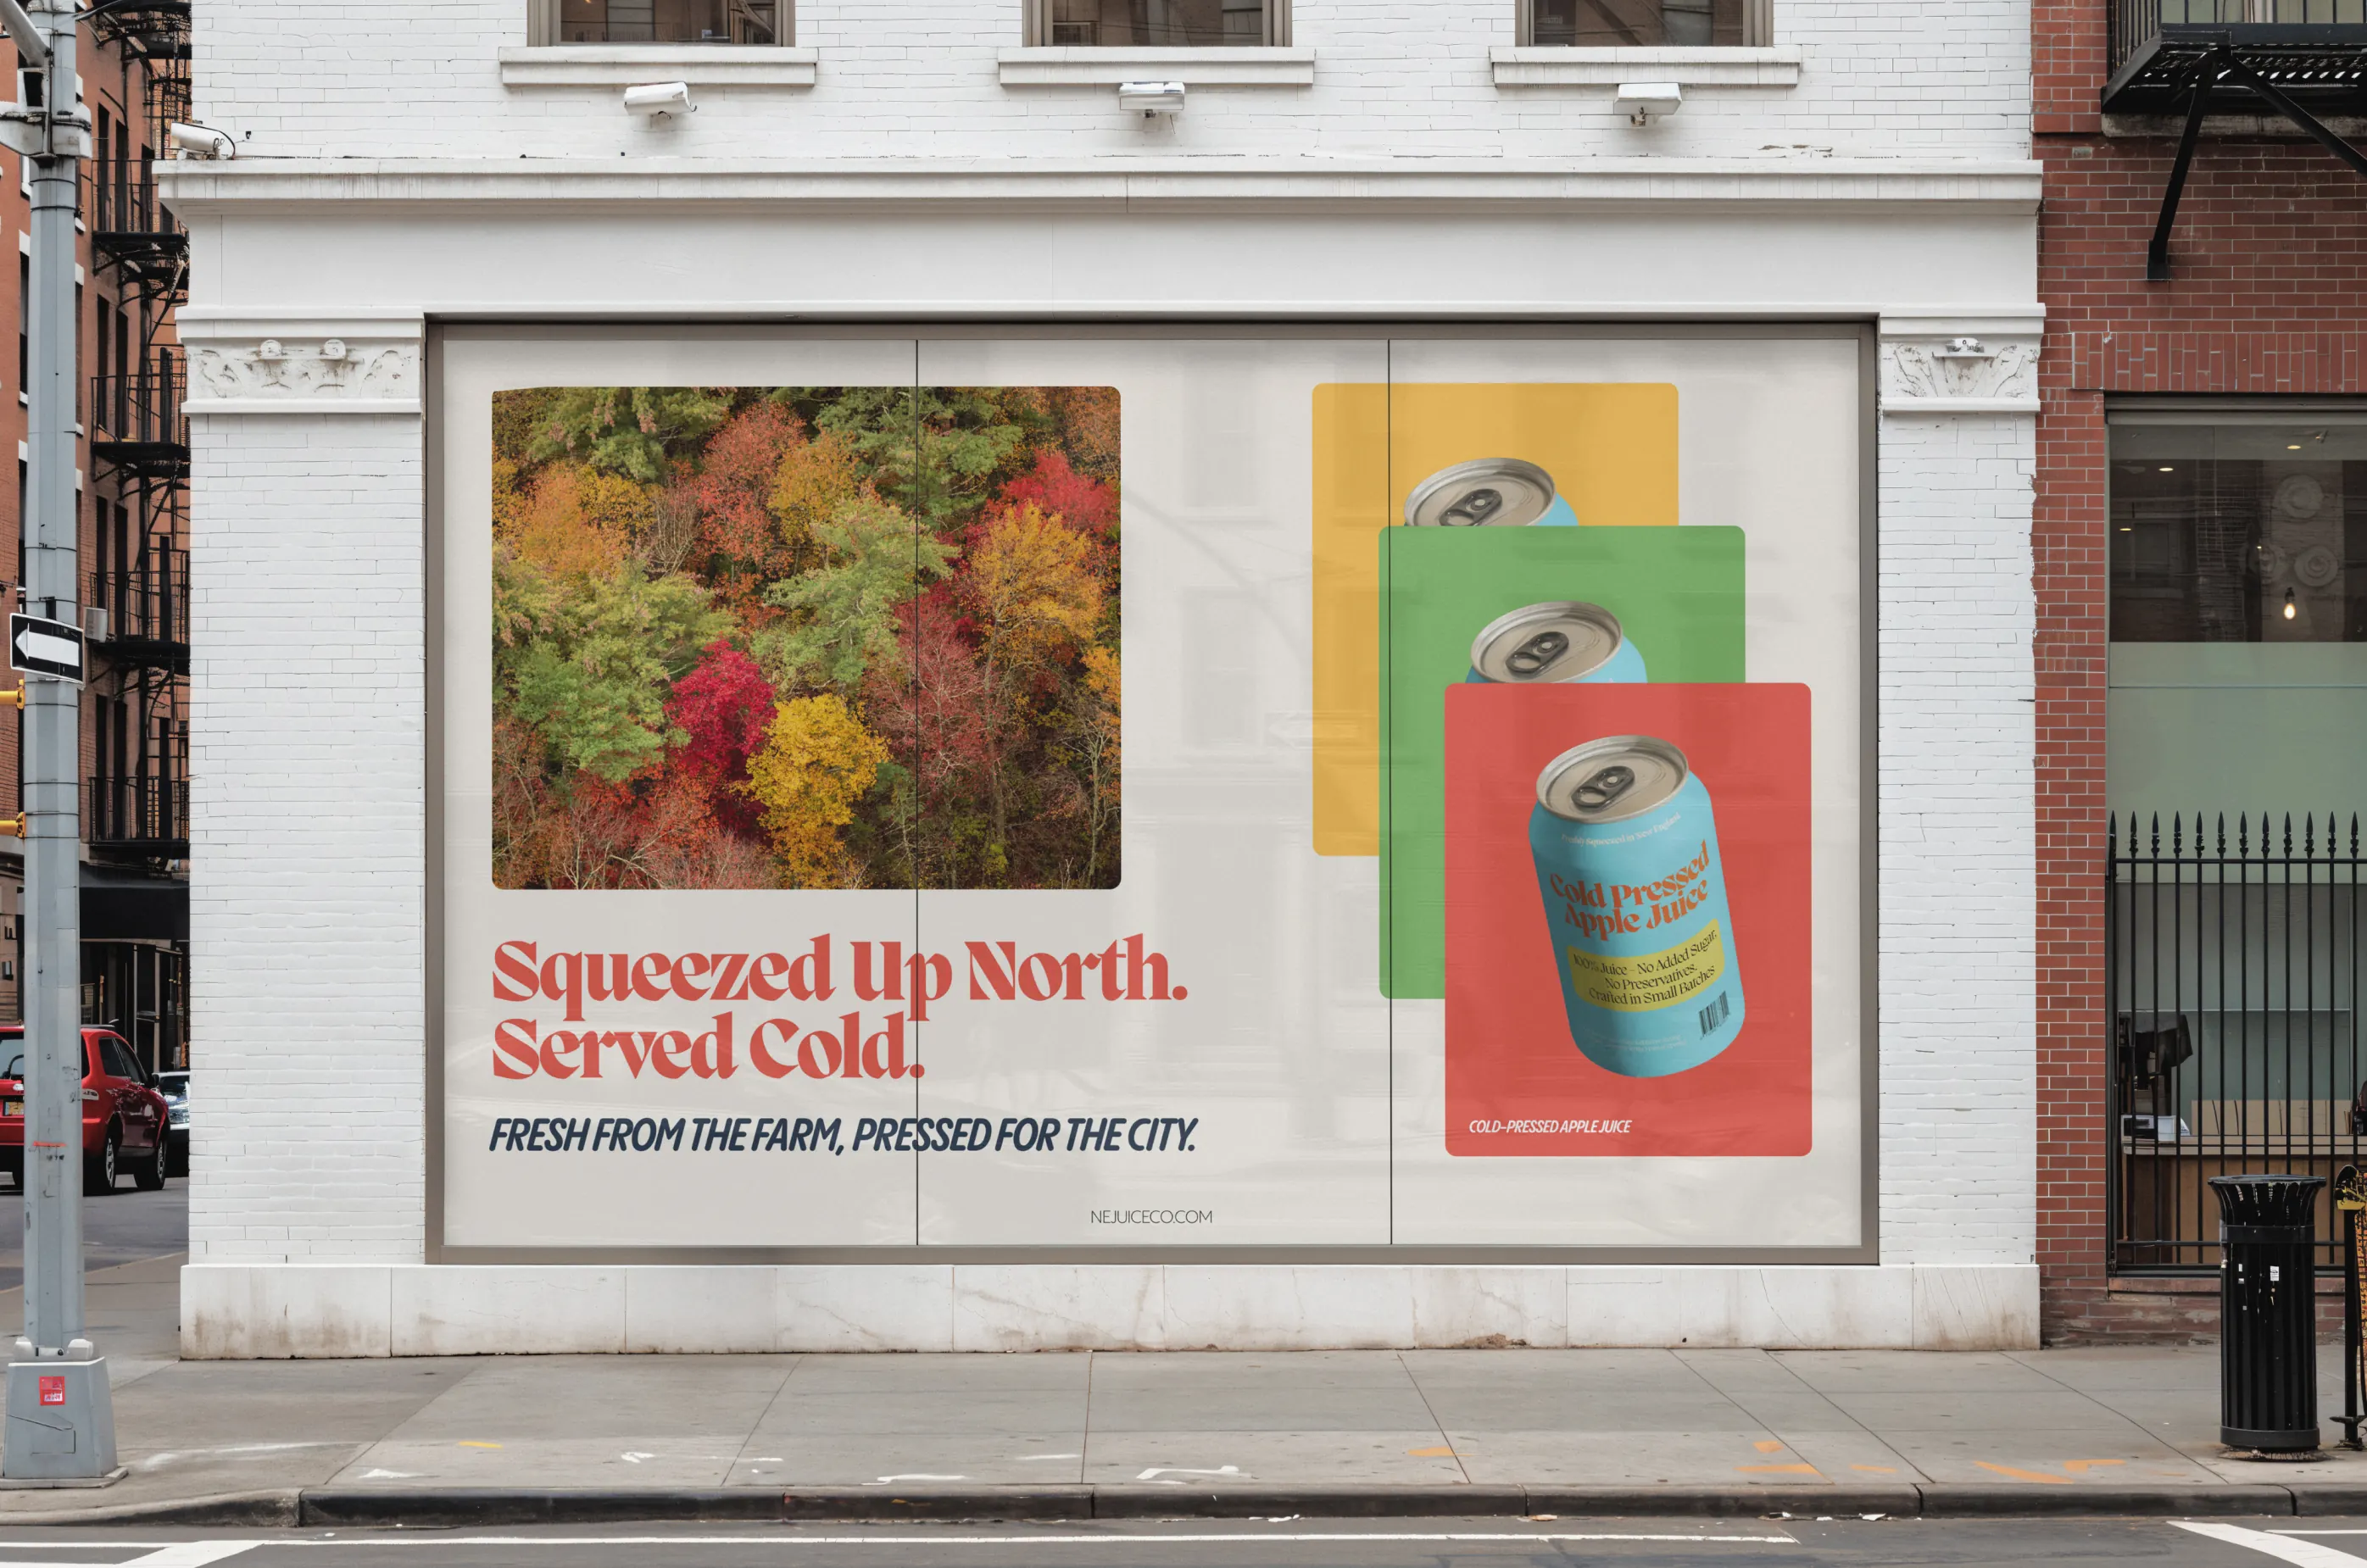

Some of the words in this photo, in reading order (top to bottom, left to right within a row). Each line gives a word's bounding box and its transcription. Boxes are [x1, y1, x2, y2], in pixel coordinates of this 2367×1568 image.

[1626, 832, 1635, 842] in
[1550, 873, 1607, 909] Cold
[1609, 838, 1710, 909] Pressed
[1565, 902, 1642, 942] Apple
[1646, 879, 1708, 930] Juice
[492, 933, 838, 1021] Squeezed
[849, 941, 953, 1021] Up
[964, 932, 1189, 1001] North.
[1573, 954, 1599, 971] 100%
[1600, 963, 1627, 976] Juice
[1637, 963, 1654, 975] No
[1656, 947, 1689, 971] Added
[1605, 976, 1621, 990] No
[1623, 963, 1698, 990] Preservatives.
[1589, 987, 1629, 1005] Crafted
[1629, 993, 1641, 1005] in
[1643, 985, 1679, 1004] Small
[1679, 965, 1716, 995] Batches
[492, 1010, 739, 1080] Served
[749, 1010, 926, 1080] Cold.
[489, 1117, 591, 1152] FRESH
[592, 1117, 686, 1152] FROM
[691, 1117, 752, 1152] THE
[751, 1117, 845, 1157] FARM,
[852, 1117, 992, 1152] PRESSED
[994, 1117, 1061, 1152] FOR
[1066, 1117, 1128, 1152] THE
[1127, 1117, 1200, 1152] CITY.
[1469, 1120, 1560, 1133] COLD-PRESSED
[1559, 1120, 1601, 1133] APPLE
[1599, 1120, 1633, 1133] JUICE
[1090, 1209, 1213, 1224] NEJUICECO.COM
